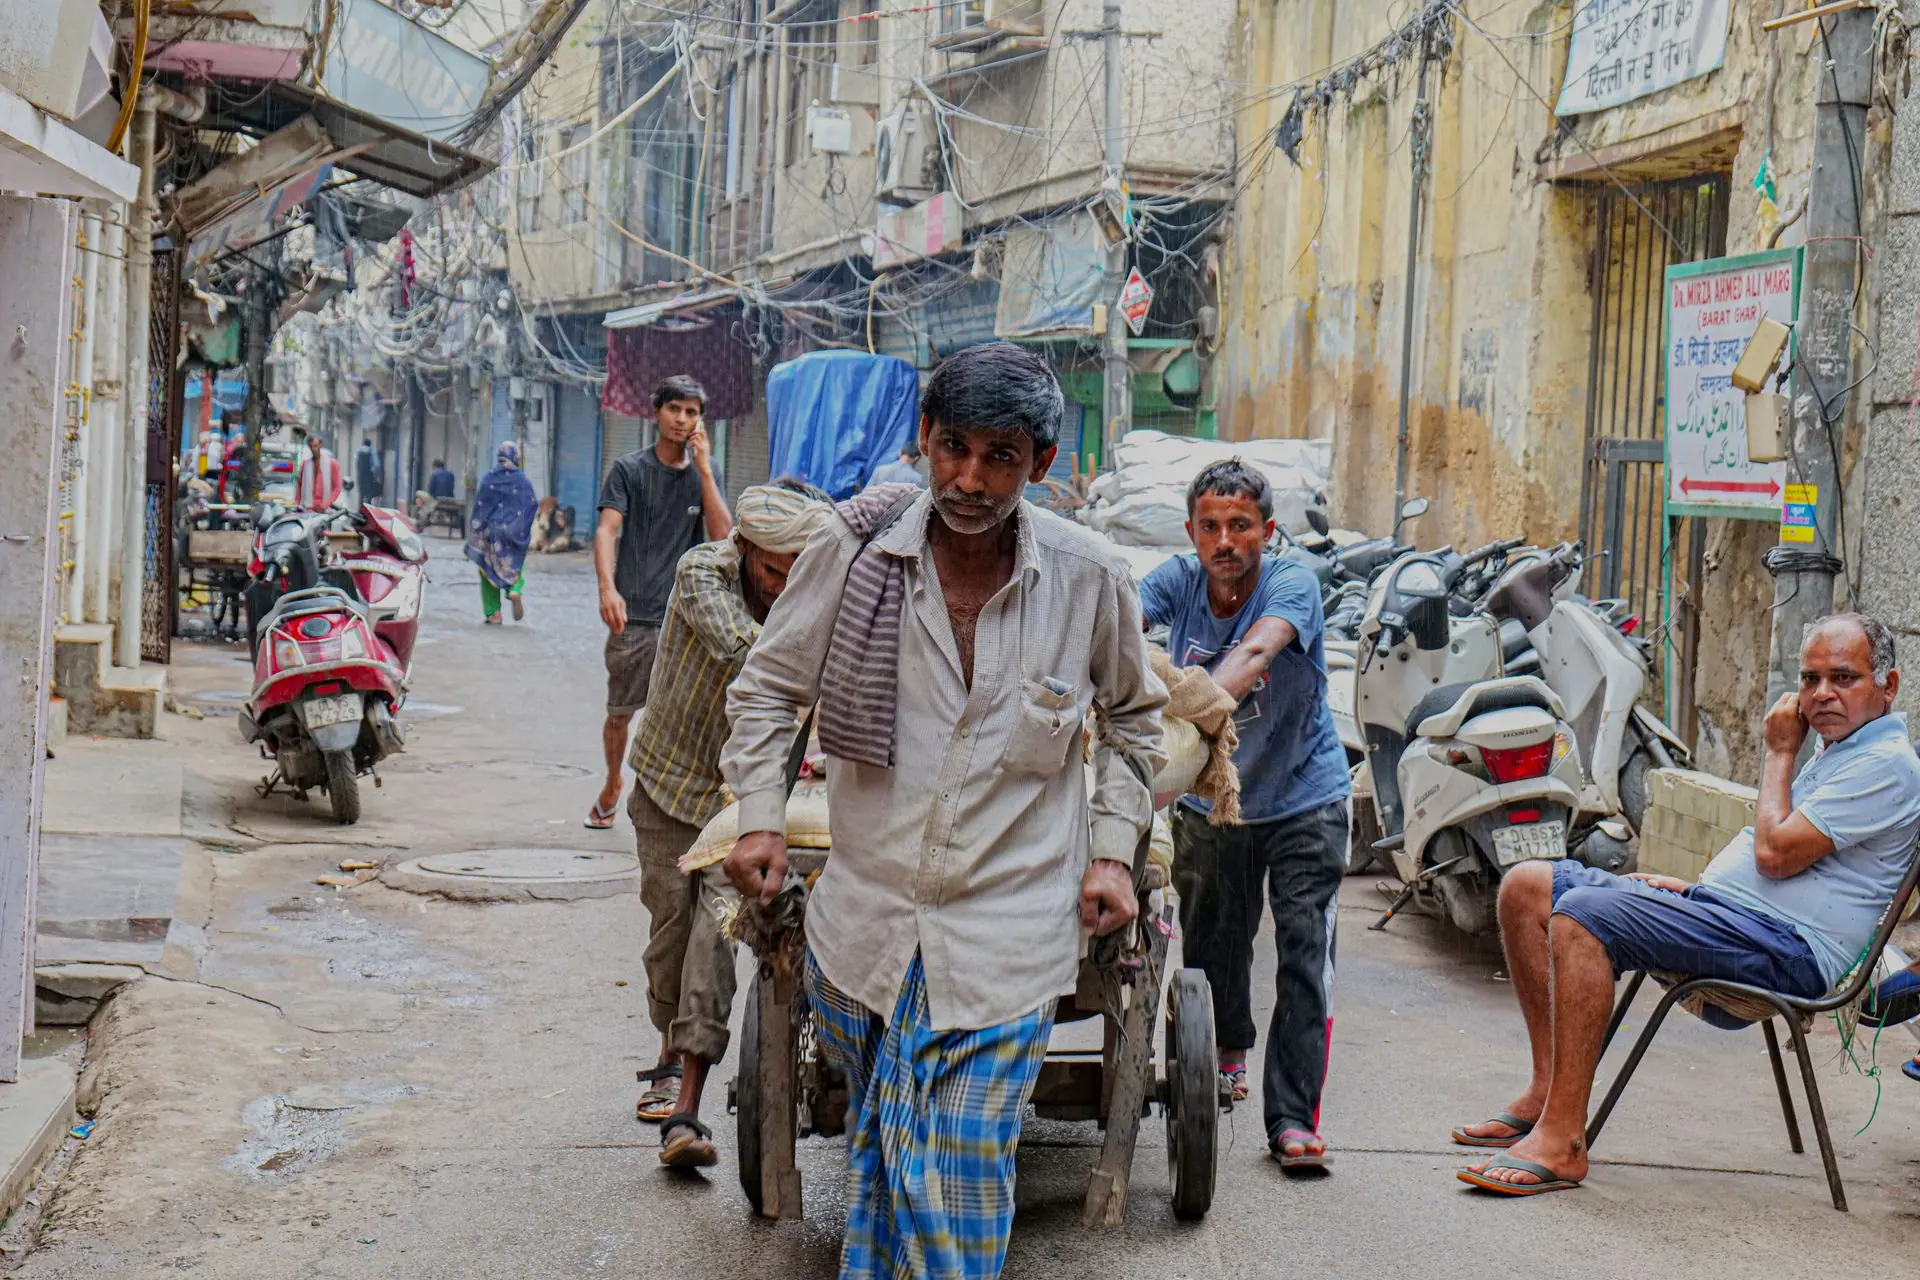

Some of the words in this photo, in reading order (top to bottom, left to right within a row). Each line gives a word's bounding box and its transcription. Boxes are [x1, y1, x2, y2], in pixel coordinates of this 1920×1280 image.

[1687, 279, 1711, 305] MIRZA
[1714, 275, 1743, 302] AHMED
[1746, 271, 1761, 297] ALI
[1764, 267, 1790, 296] MARG
[1503, 728, 1538, 738] HONDA
